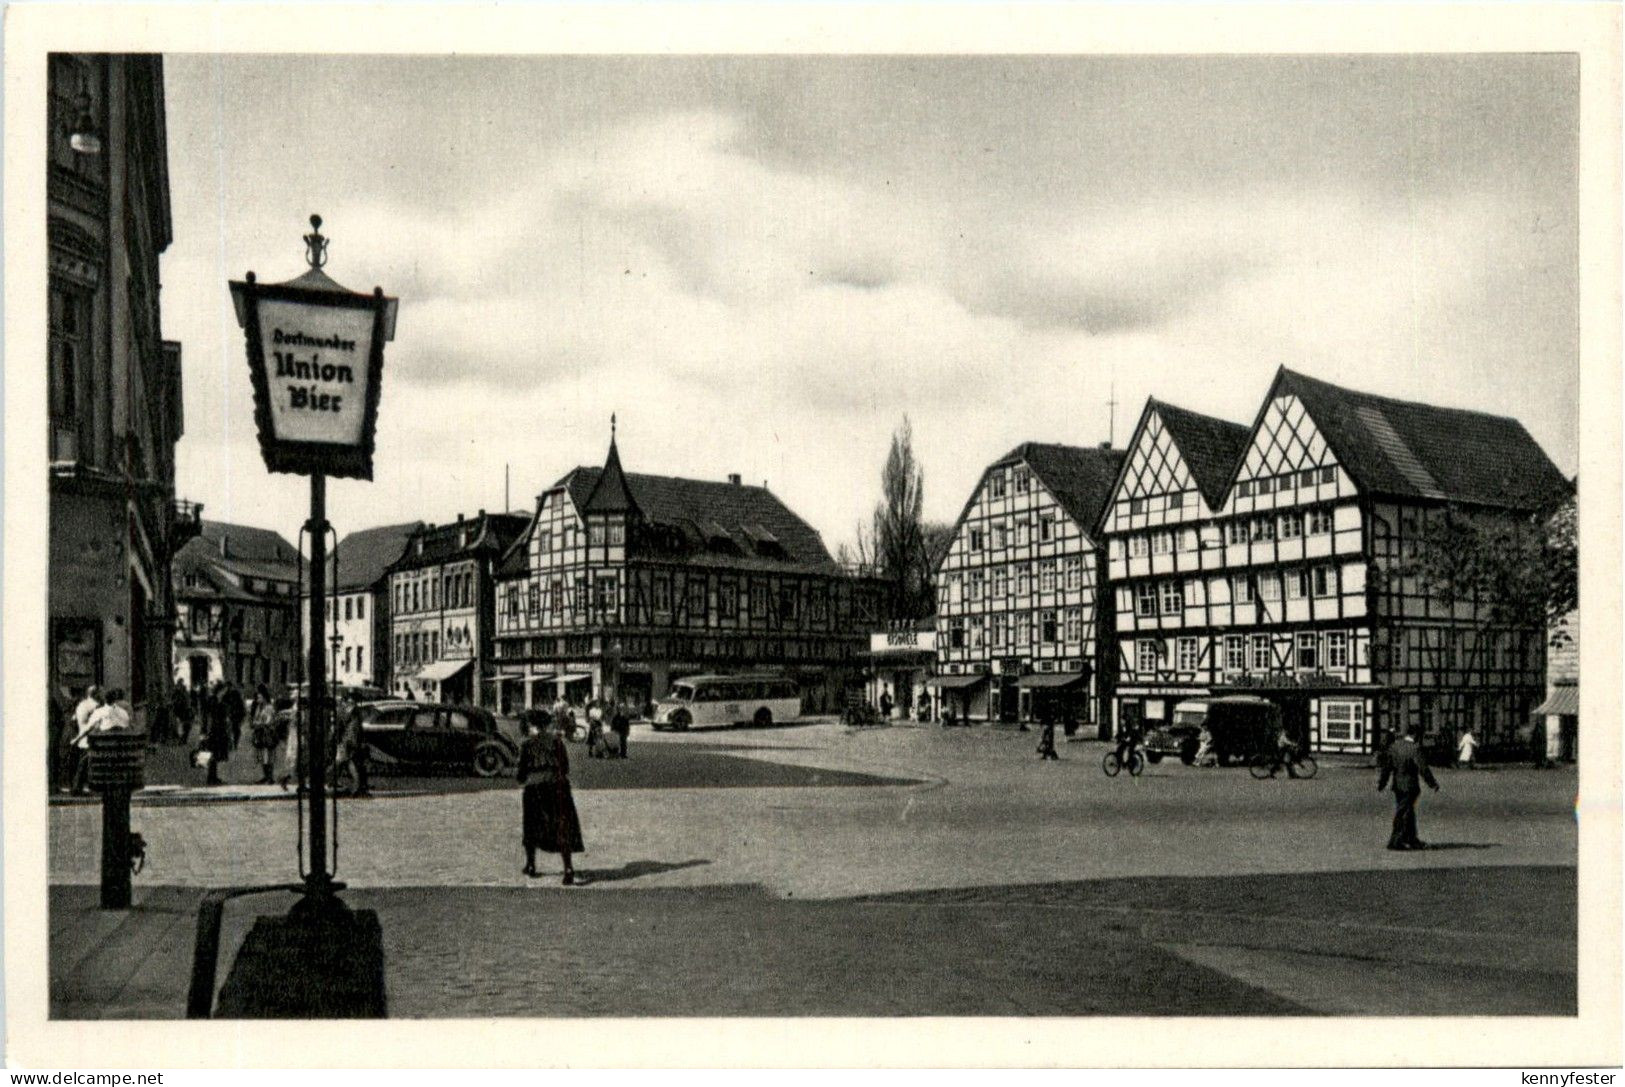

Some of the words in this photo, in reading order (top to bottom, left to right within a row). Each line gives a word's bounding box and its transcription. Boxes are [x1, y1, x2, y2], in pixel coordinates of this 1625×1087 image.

[273, 328, 356, 351] Dortmunder
[273, 351, 354, 383] Union
[287, 385, 342, 412] Bier
